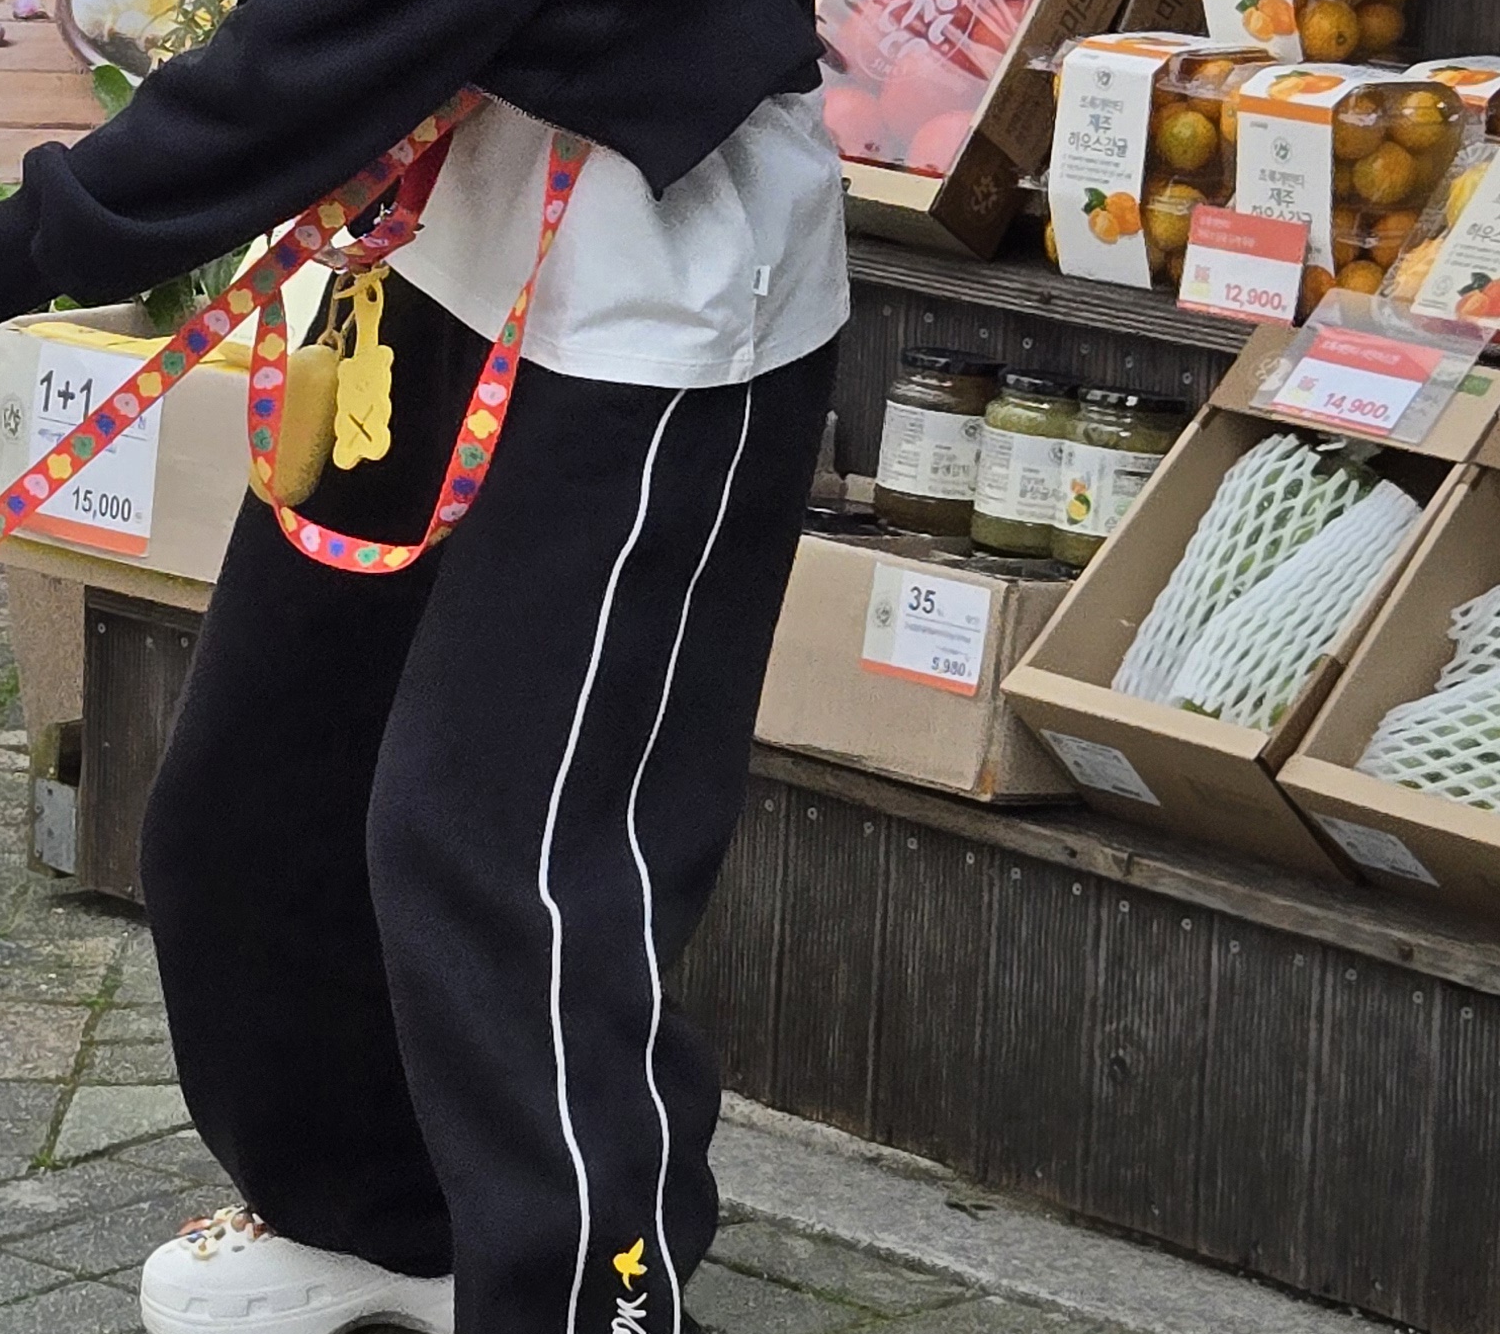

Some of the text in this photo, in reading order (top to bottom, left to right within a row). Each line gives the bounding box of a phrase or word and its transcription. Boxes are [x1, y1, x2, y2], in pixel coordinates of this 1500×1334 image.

[1088, 112, 1113, 134] 제주
[1067, 130, 1129, 159] 하우스감귤
[1269, 187, 1296, 208] 제주
[40, 369, 94, 422] 1+1
